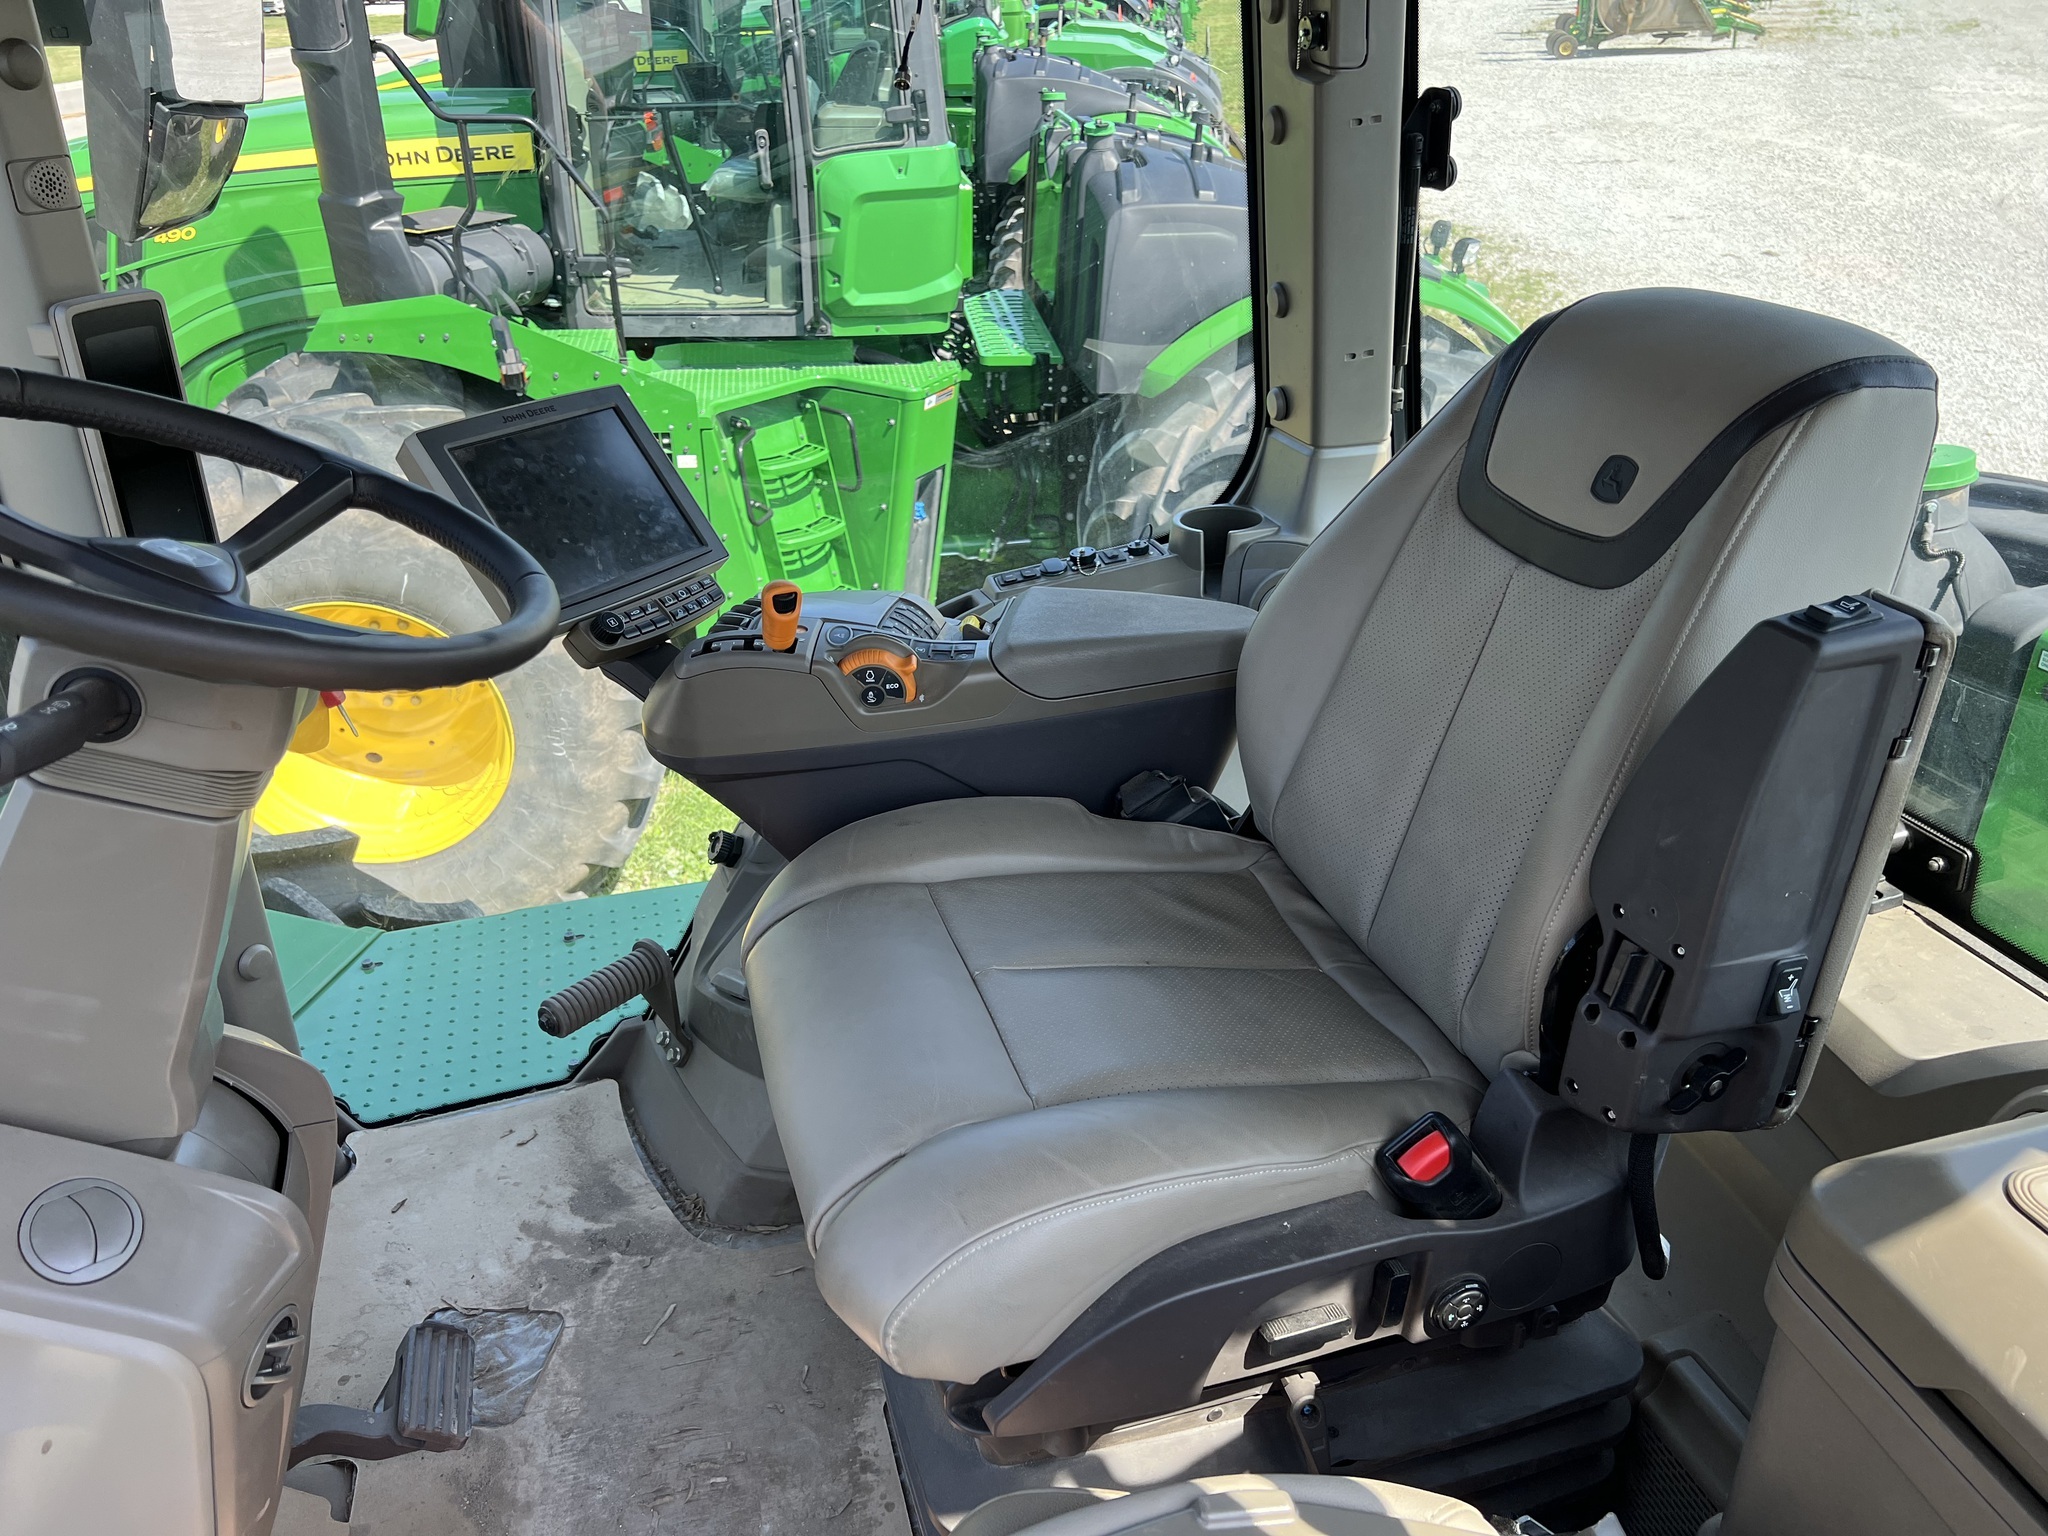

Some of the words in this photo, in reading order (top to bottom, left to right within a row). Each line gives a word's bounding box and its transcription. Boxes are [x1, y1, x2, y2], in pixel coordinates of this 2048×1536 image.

[637, 55, 679, 66] DEERE
[387, 150, 430, 166] OHN
[436, 145, 516, 163] DEERE
[153, 226, 197, 244] 490
[502, 412, 527, 424] JOHN
[526, 405, 557, 418] DEERE
[885, 682, 899, 690] ECO
